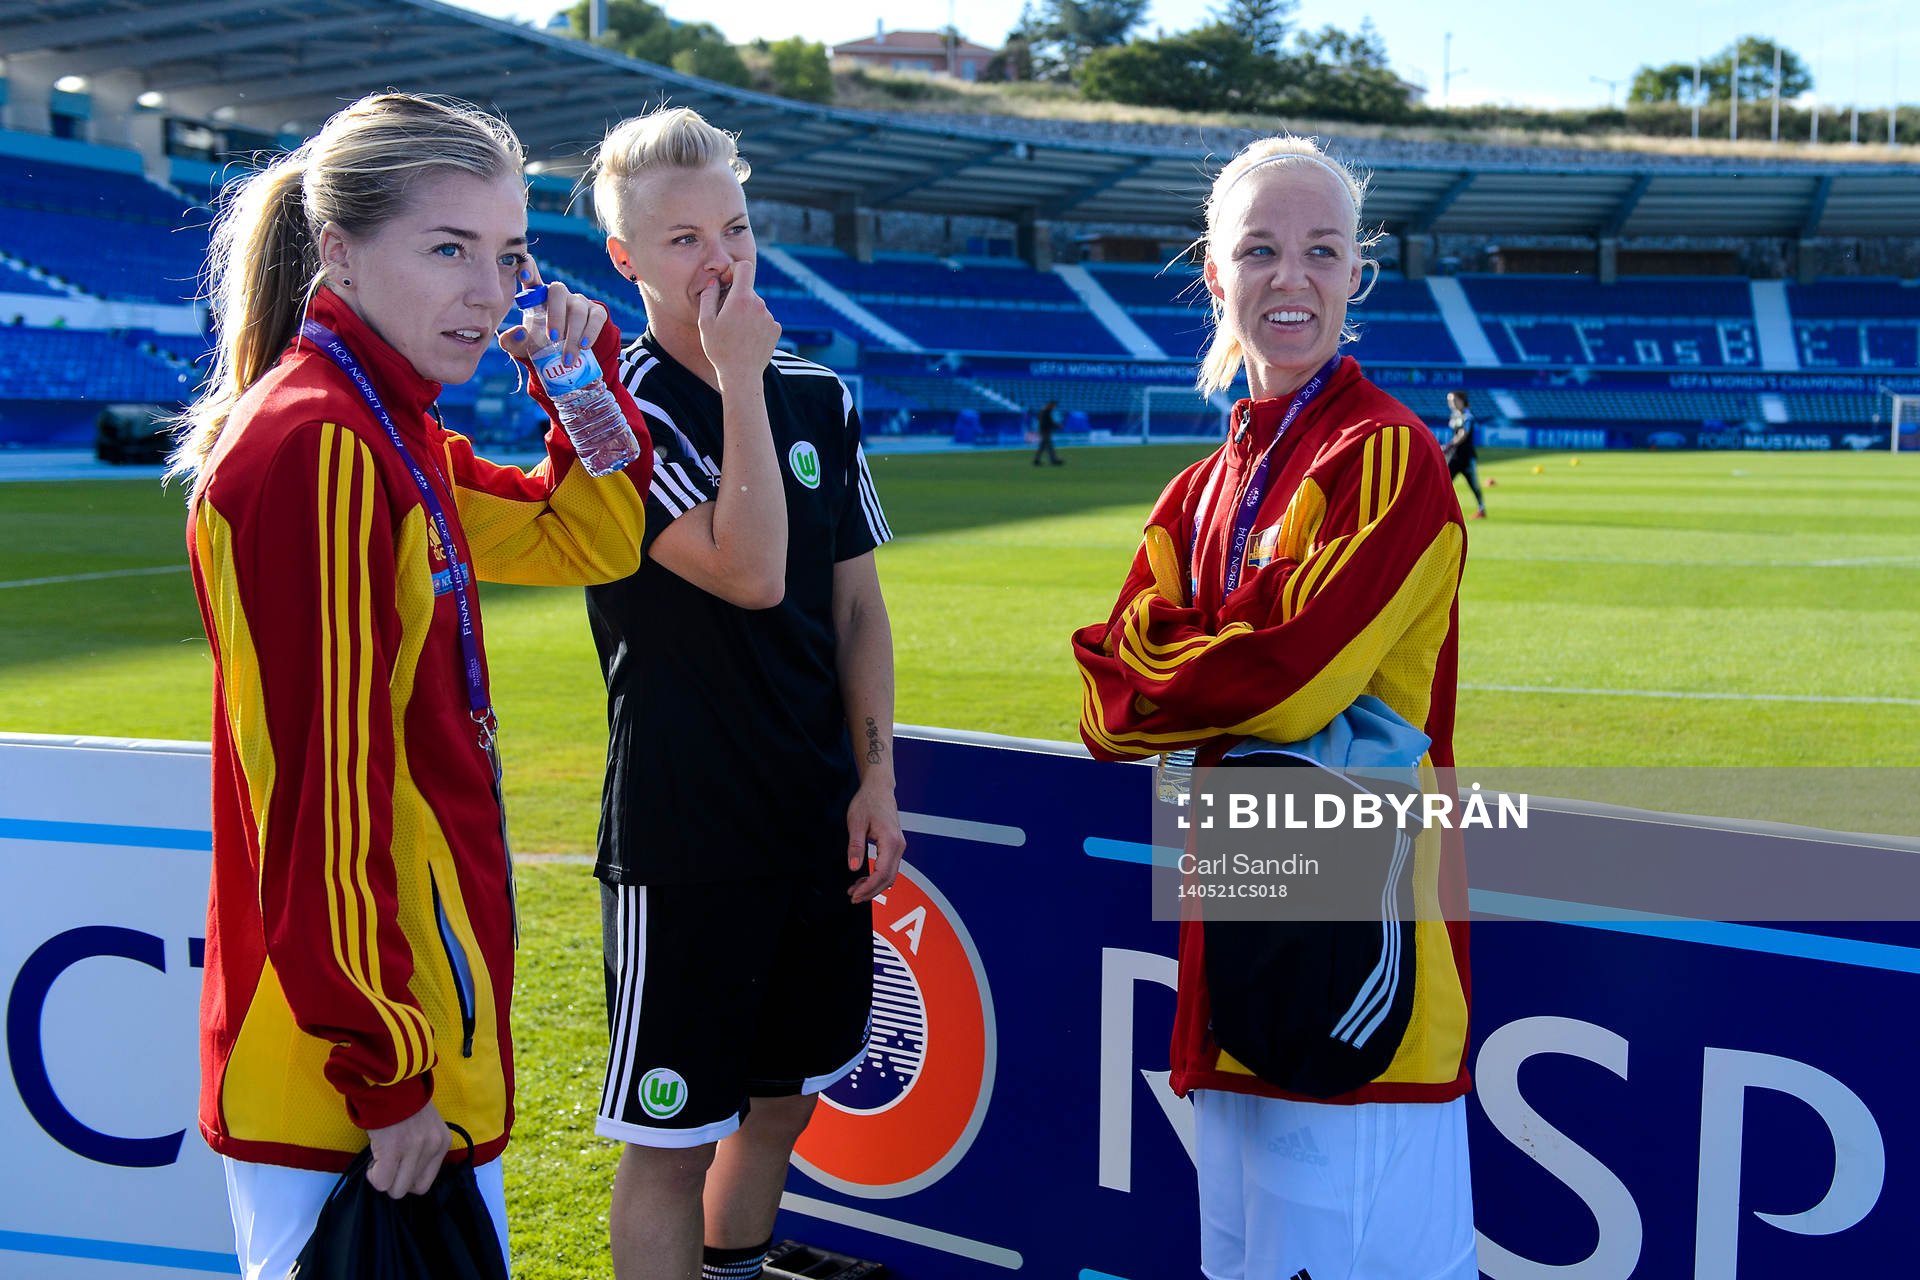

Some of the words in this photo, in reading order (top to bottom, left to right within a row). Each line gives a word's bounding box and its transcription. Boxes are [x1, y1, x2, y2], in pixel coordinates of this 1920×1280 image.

[328, 341, 353, 364] 2014
[349, 366, 381, 408] LISBON
[1301, 377, 1321, 399] 2014
[1669, 374, 1709, 388] UEFA
[1710, 375, 1777, 389] WOMEN'S
[1780, 375, 1864, 390] CHAMPIONS
[381, 412, 403, 447] FINAL
[1537, 429, 1607, 449] GAZPROM
[1744, 433, 1830, 450] MUSTANG
[436, 512, 450, 540] 2014
[1226, 556, 1240, 596] ISBON
[1233, 526, 1248, 553] 2014
[463, 595, 472, 636] FINAL
